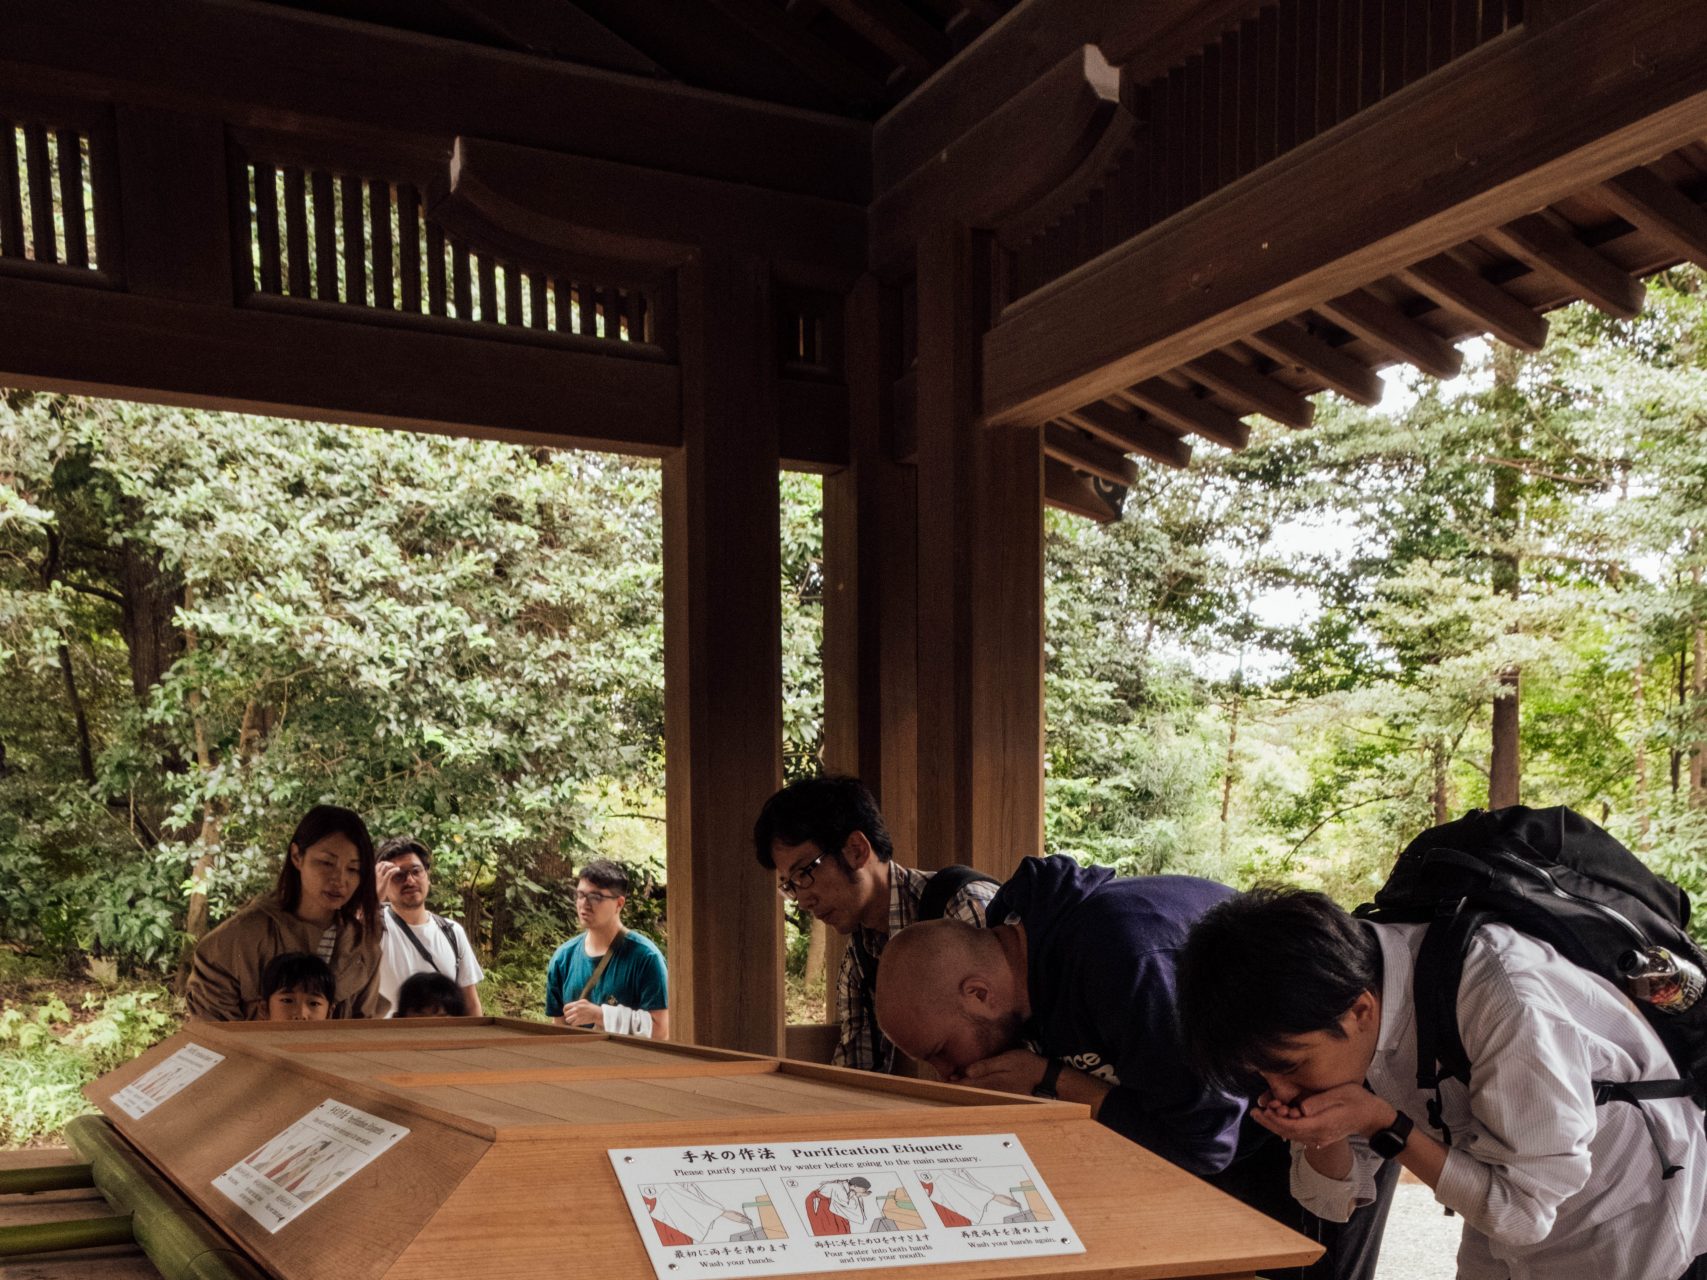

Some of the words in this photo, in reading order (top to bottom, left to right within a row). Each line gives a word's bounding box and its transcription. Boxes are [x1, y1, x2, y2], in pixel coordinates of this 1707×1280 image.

[682, 1148, 776, 1163] 手水の作法
[791, 1145, 889, 1158] Purification
[892, 1142, 964, 1155] Etiquette
[674, 1168, 704, 1177] Please
[707, 1167, 737, 1176] purify
[740, 1165, 777, 1175] yourself
[780, 1164, 793, 1172] by
[825, 1161, 854, 1169] before
[856, 1160, 882, 1168] going
[937, 1156, 982, 1165] sanctuary.
[1034, 1237, 1057, 1245] again.
[674, 1243, 788, 1259] 最初に両手を清めます
[824, 1250, 844, 1258] Pour
[909, 1244, 933, 1252] hands
[878, 1254, 897, 1262] your
[899, 1252, 926, 1260] mouth.
[699, 1259, 725, 1268] Wash
[726, 1259, 746, 1268] your
[748, 1256, 775, 1265] hands.
